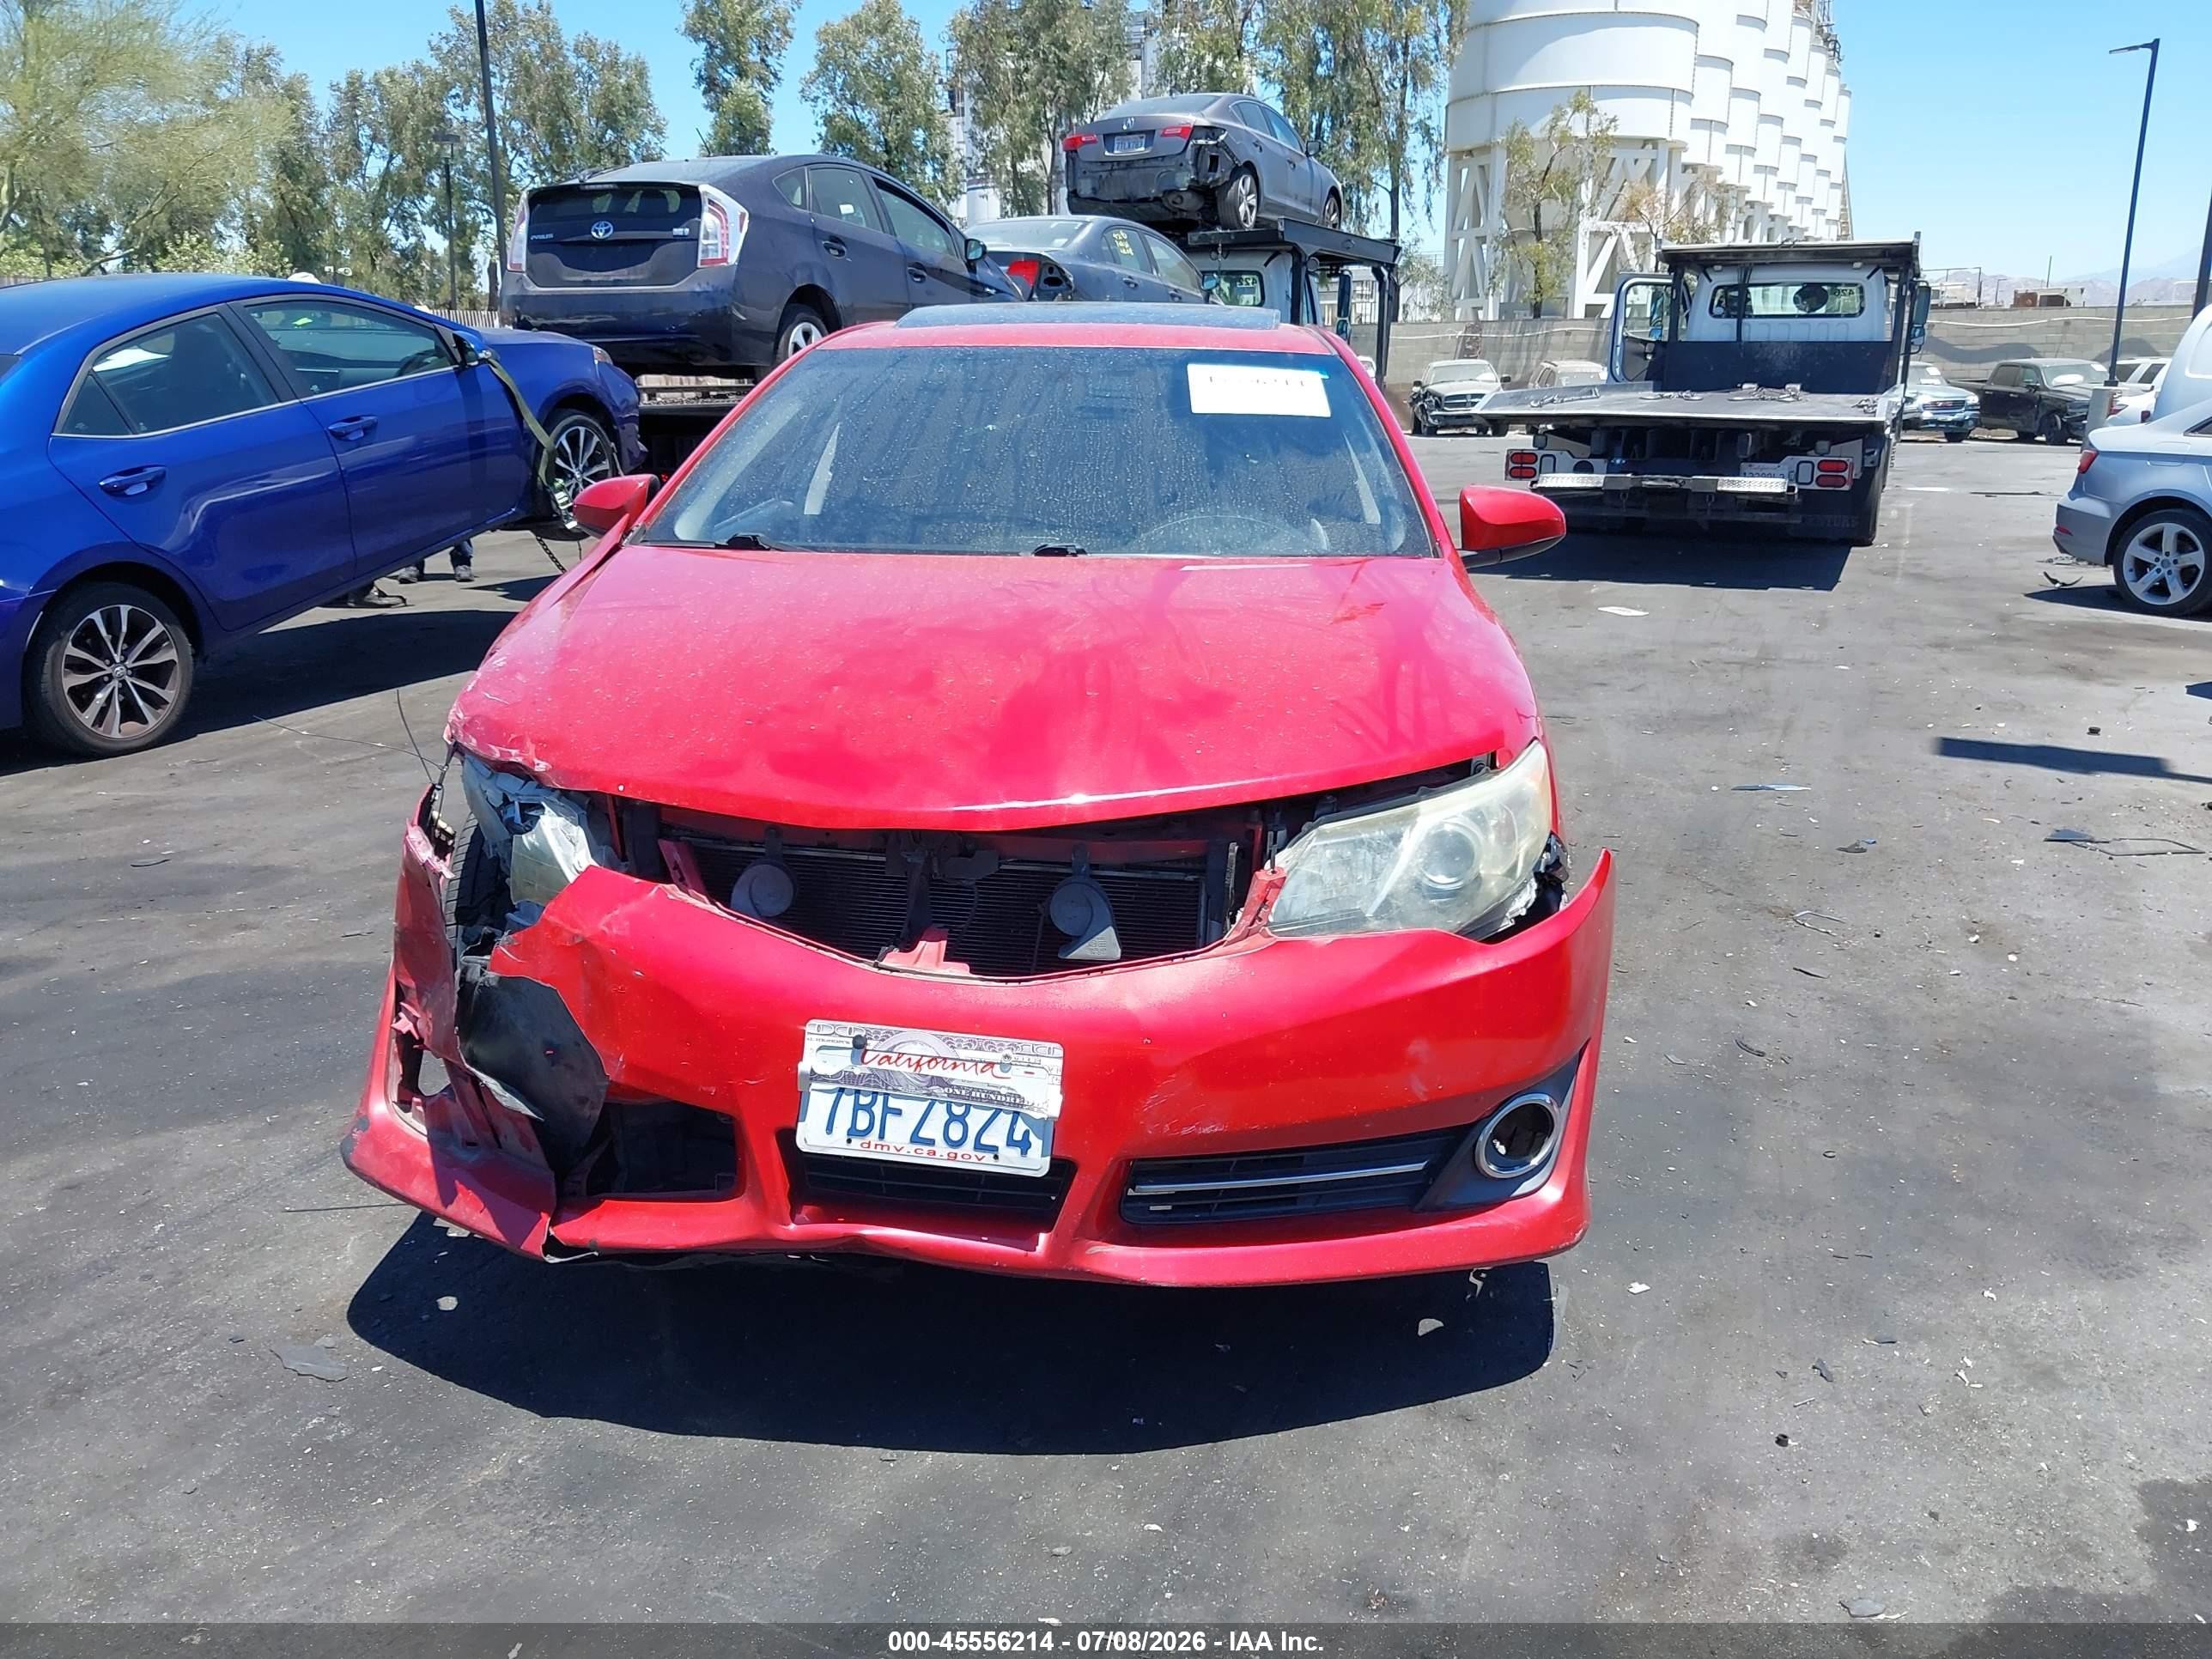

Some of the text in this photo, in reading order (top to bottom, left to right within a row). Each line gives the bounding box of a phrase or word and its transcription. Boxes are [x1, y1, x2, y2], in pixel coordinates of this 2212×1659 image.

[860, 1048, 1011, 1079] California
[944, 1087, 970, 1097] ONE
[860, 1139, 987, 1163] dmv.ca.gov
